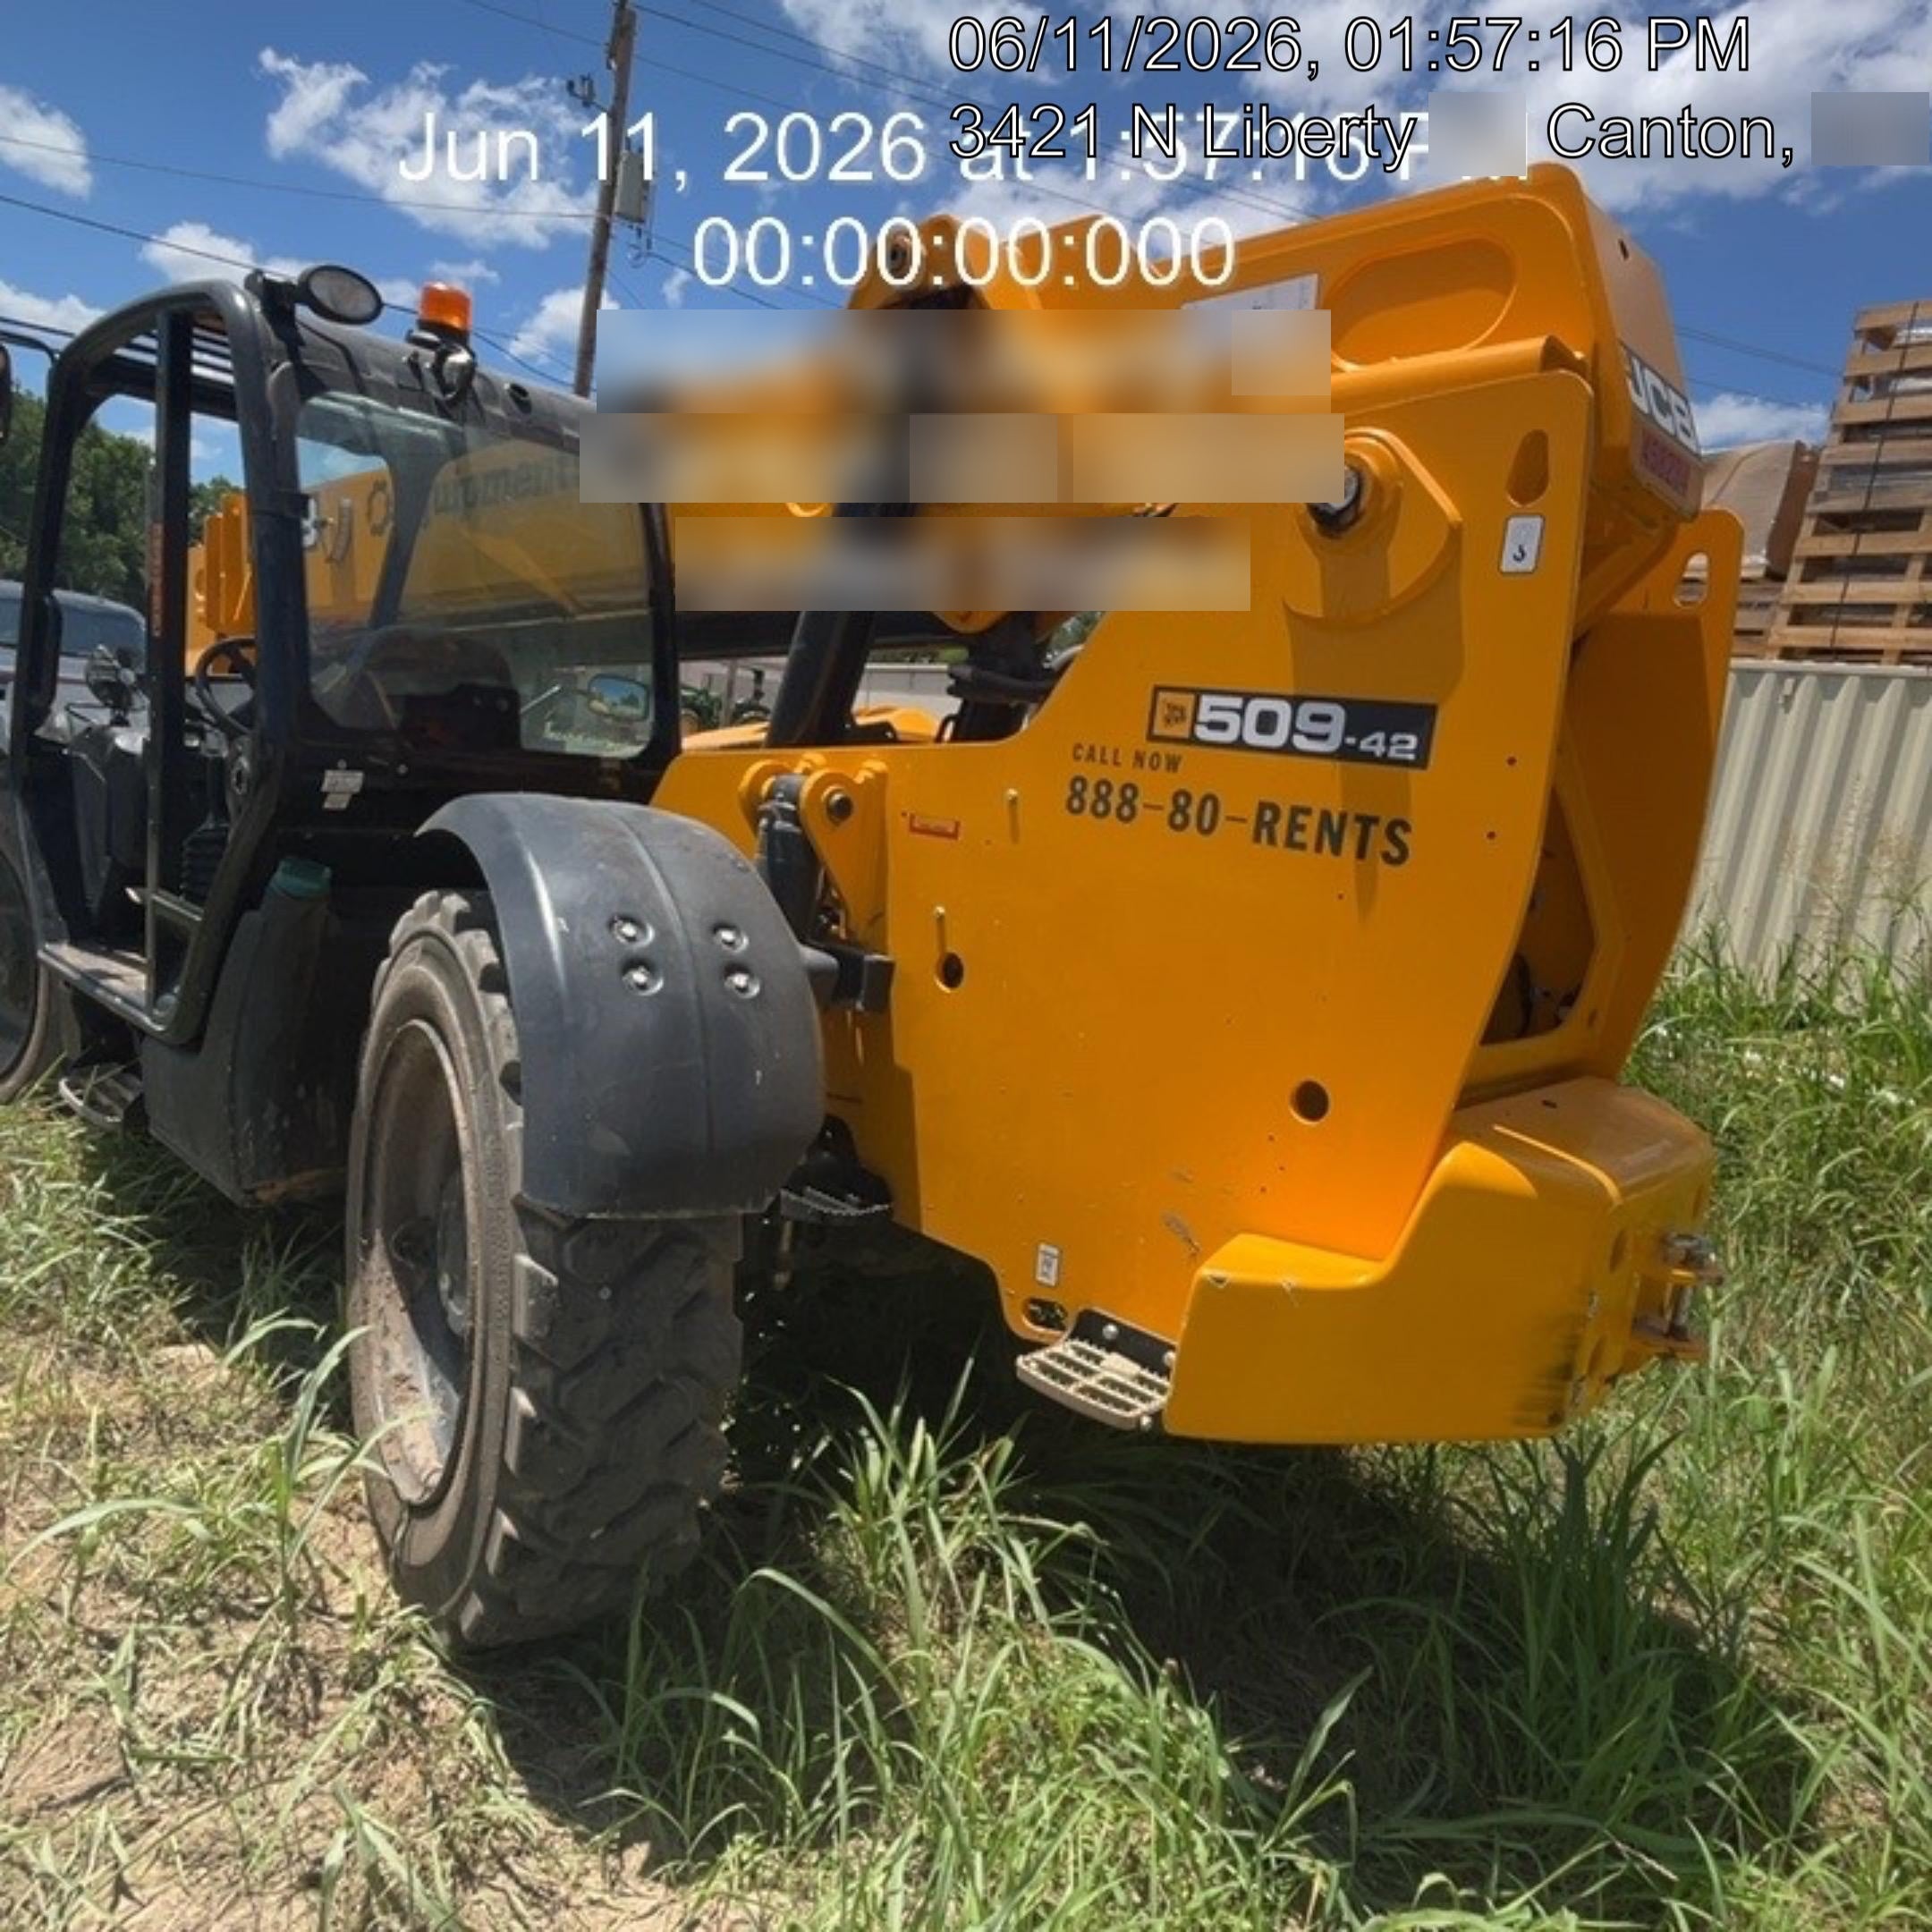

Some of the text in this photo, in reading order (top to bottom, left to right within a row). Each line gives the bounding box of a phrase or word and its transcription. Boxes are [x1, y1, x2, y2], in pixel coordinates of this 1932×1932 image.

[1627, 355, 1701, 455] JCB
[1072, 743, 1182, 773] CALL NOW
[1193, 693, 1419, 760] 509-42
[1066, 775, 1412, 866] 888-80-RENTS
